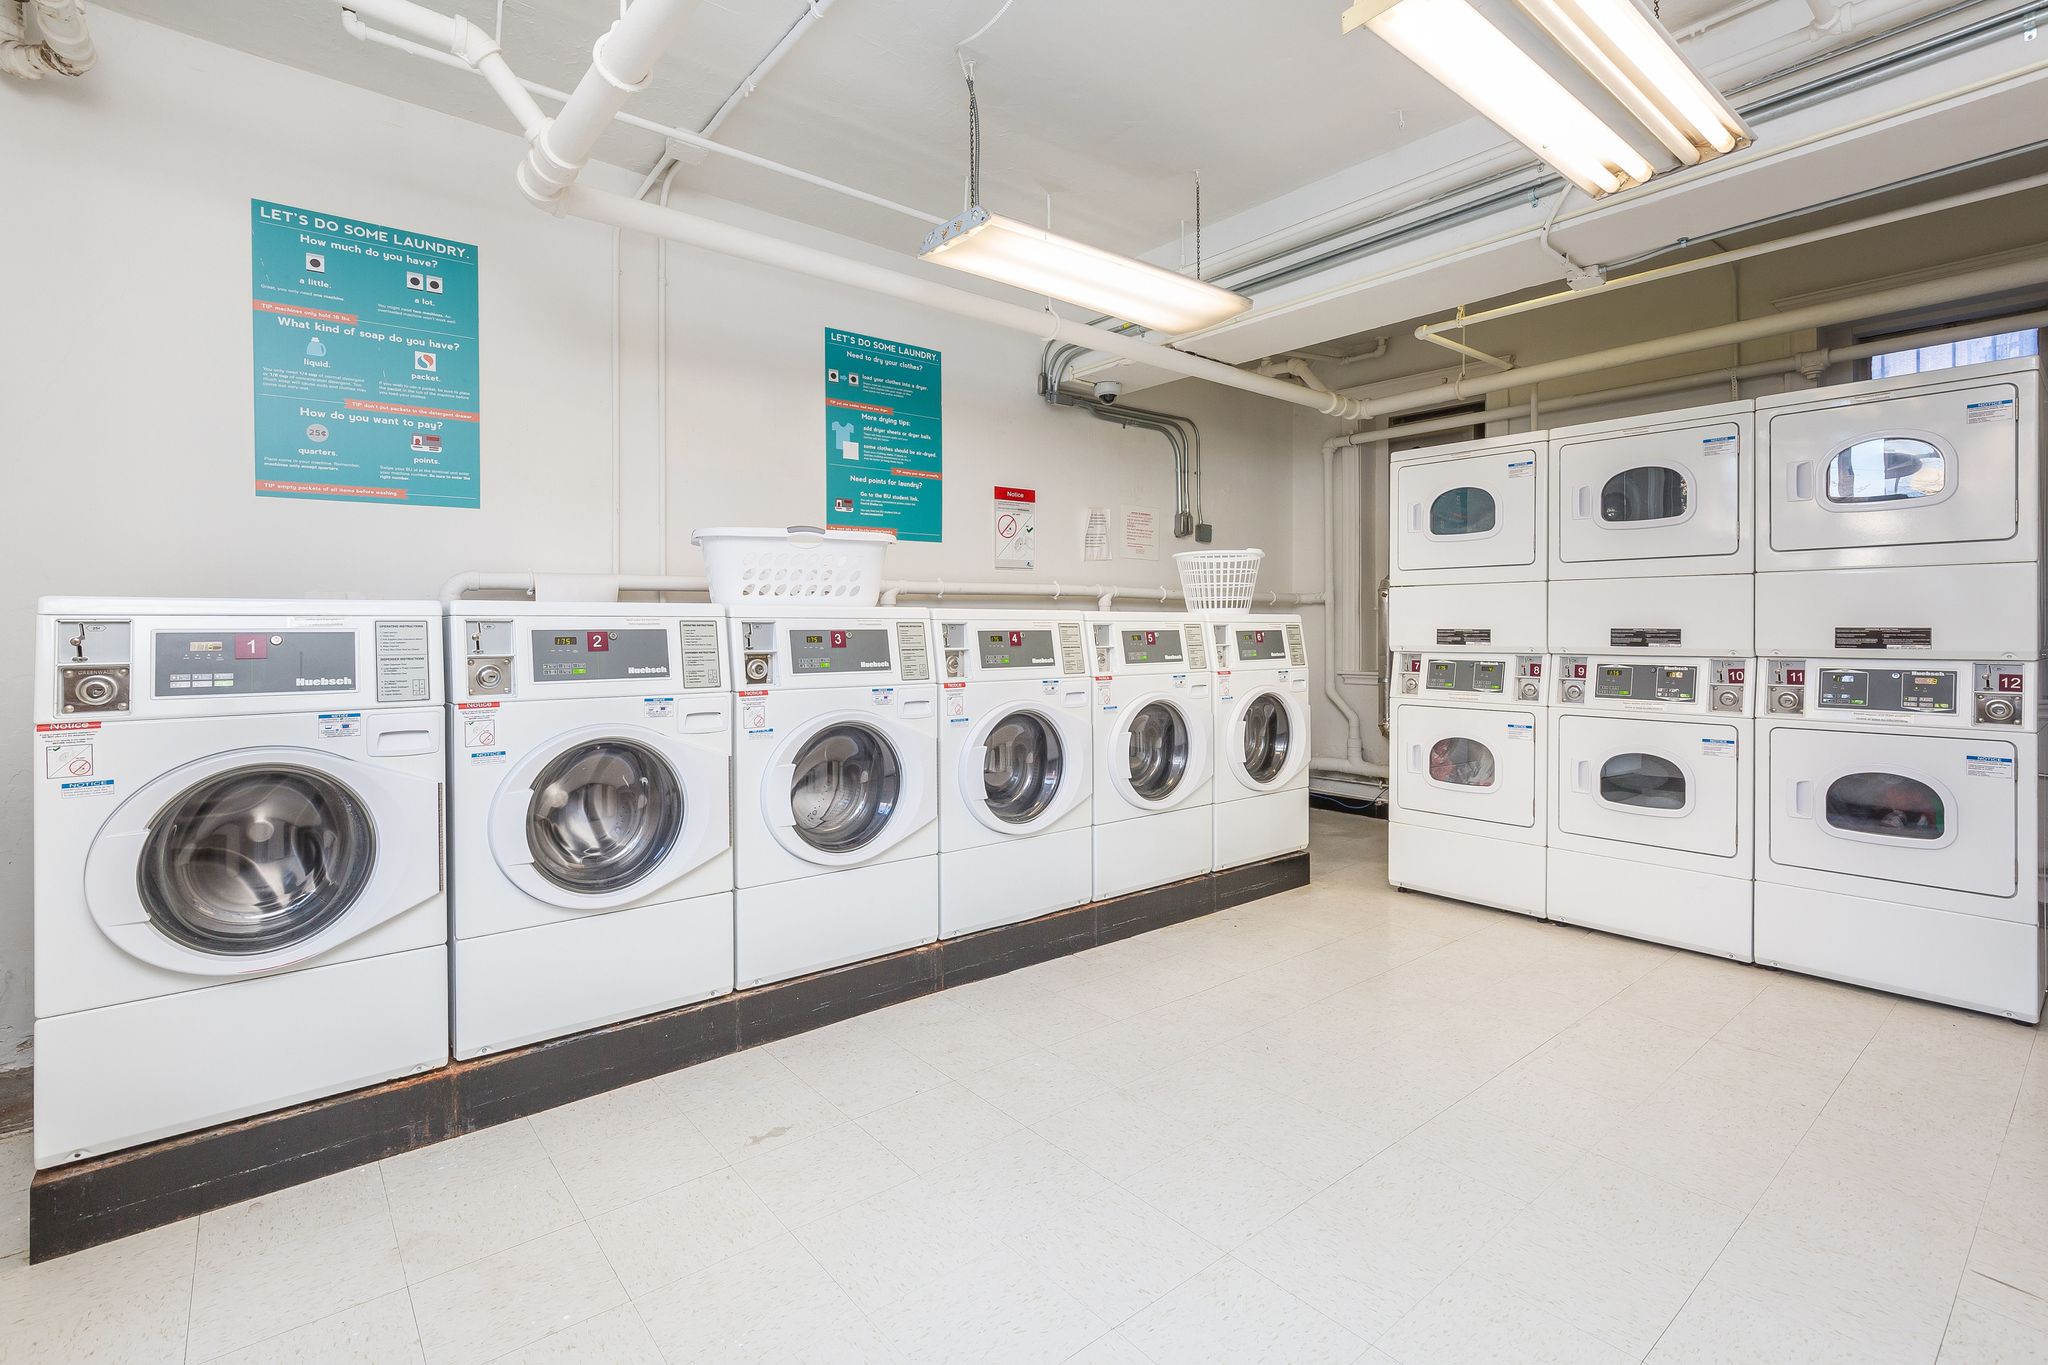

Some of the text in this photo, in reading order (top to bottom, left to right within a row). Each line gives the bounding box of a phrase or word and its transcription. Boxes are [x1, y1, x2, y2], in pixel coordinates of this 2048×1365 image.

[260, 206, 470, 259] LET'S DO SOME LAUNDRY.
[300, 234, 439, 268] How much do you have?
[308, 278, 332, 289] little.
[422, 298, 435, 306] lot.
[275, 306, 302, 314] machines
[277, 316, 460, 351] What kind of soap do you have?
[830, 332, 939, 362] LET'S DO SOME LAUNDRY.
[303, 358, 331, 368] liquid.
[846, 351, 864, 360] Need
[873, 356, 883, 365] dry
[899, 362, 923, 371] clothes?
[411, 373, 441, 382] packet.
[884, 378, 901, 386] clothes
[300, 407, 443, 431] How do you want to pay?
[861, 413, 877, 421] More
[878, 416, 898, 426] drying
[309, 429, 327, 437] 25¢
[298, 448, 338, 457] quarters.
[413, 457, 441, 465] points.
[850, 475, 867, 483] Need
[898, 480, 923, 490] laundry?
[1006, 491, 1025, 499] Notice
[592, 635, 602, 648] 2
[834, 634, 842, 644] 3
[1012, 634, 1018, 643] 4
[1148, 634, 1153, 642] 5
[247, 639, 255, 654] 1
[628, 666, 667, 674] Huebsch
[1415, 662, 1419, 670] 7
[1533, 666, 1540, 674] 8
[1578, 668, 1585, 676] 9
[1728, 671, 1744, 680] 10
[295, 677, 352, 686] Huebsch
[1790, 673, 1803, 681] 11
[2000, 678, 2021, 689] 12
[49, 722, 89, 730] Notice
[69, 780, 107, 788] NOTICE
